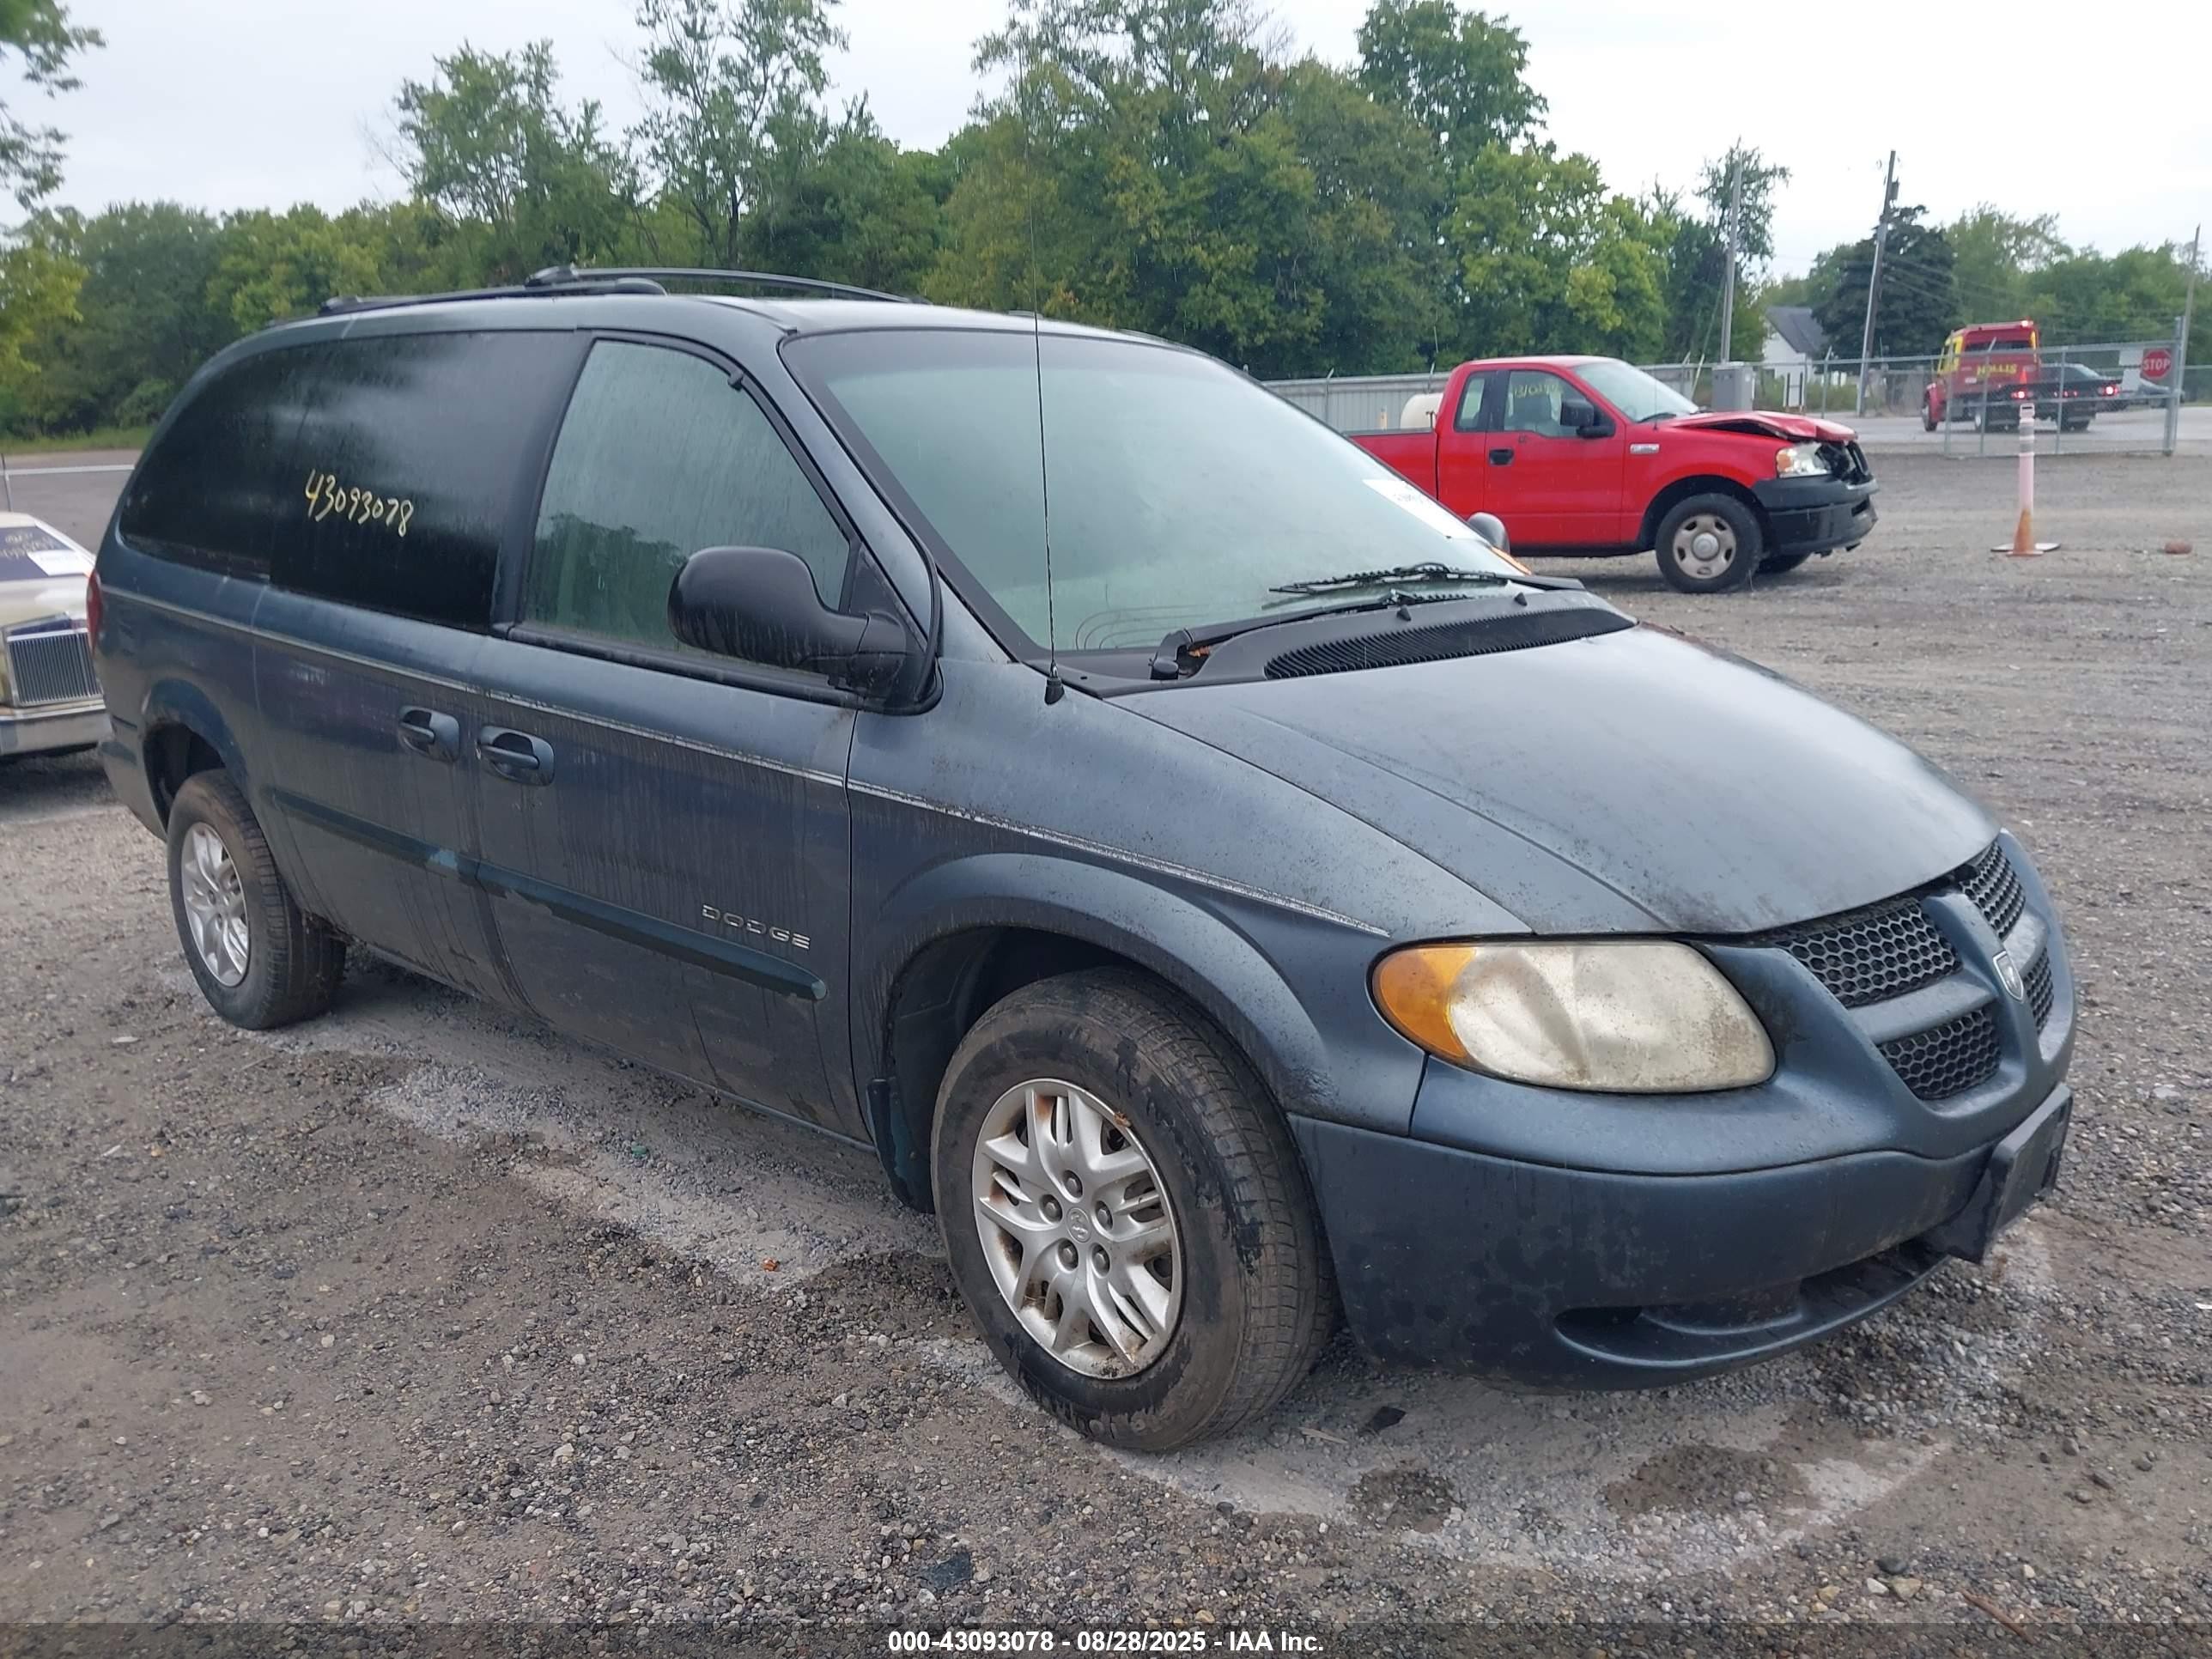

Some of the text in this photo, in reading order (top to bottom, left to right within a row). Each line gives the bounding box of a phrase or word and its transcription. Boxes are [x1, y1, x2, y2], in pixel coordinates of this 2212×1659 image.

[2142, 358, 2171, 370] STOP
[305, 468, 415, 538] 43093078
[702, 904, 811, 950] DODGE
